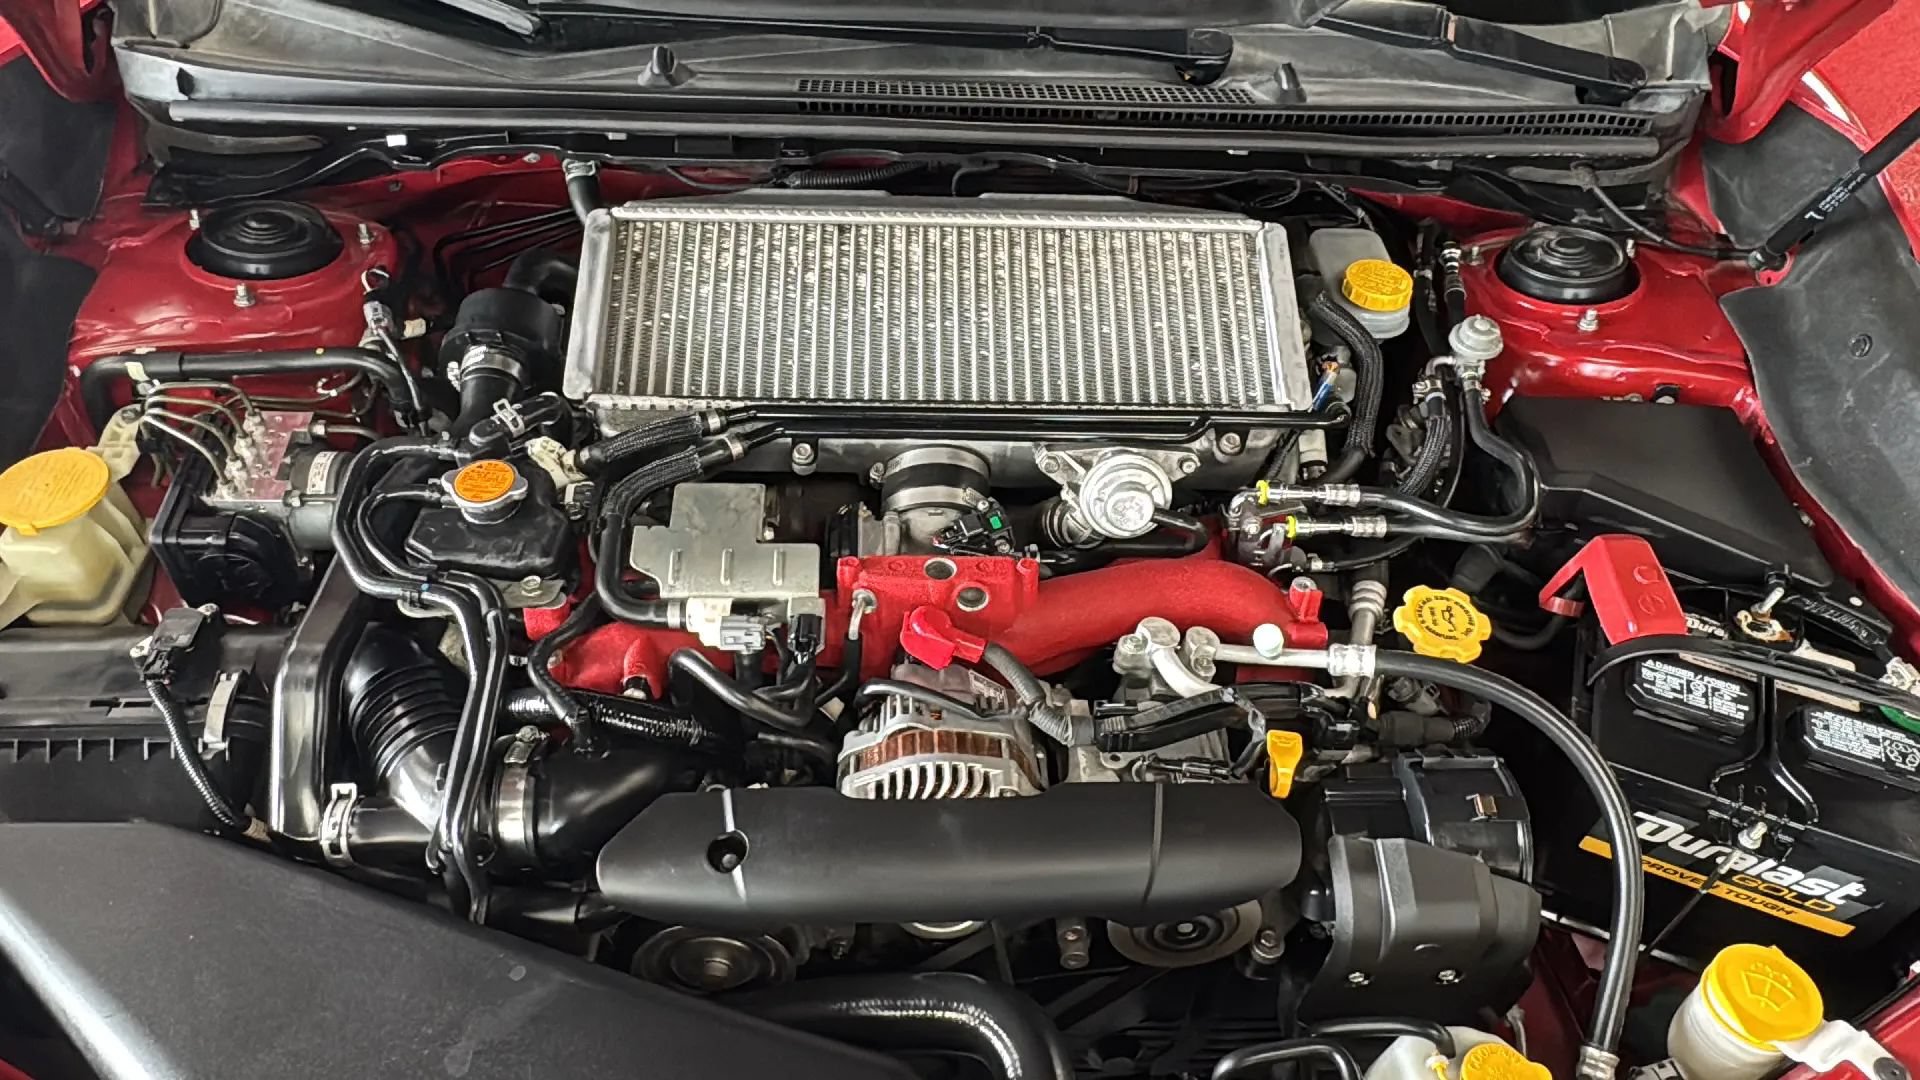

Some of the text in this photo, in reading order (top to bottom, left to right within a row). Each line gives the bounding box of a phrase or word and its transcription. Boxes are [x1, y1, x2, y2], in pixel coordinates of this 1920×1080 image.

[1655, 662, 1695, 679] DANGER
[1725, 888, 1795, 915] TOUGH
[1732, 874, 1836, 912] GOLD
